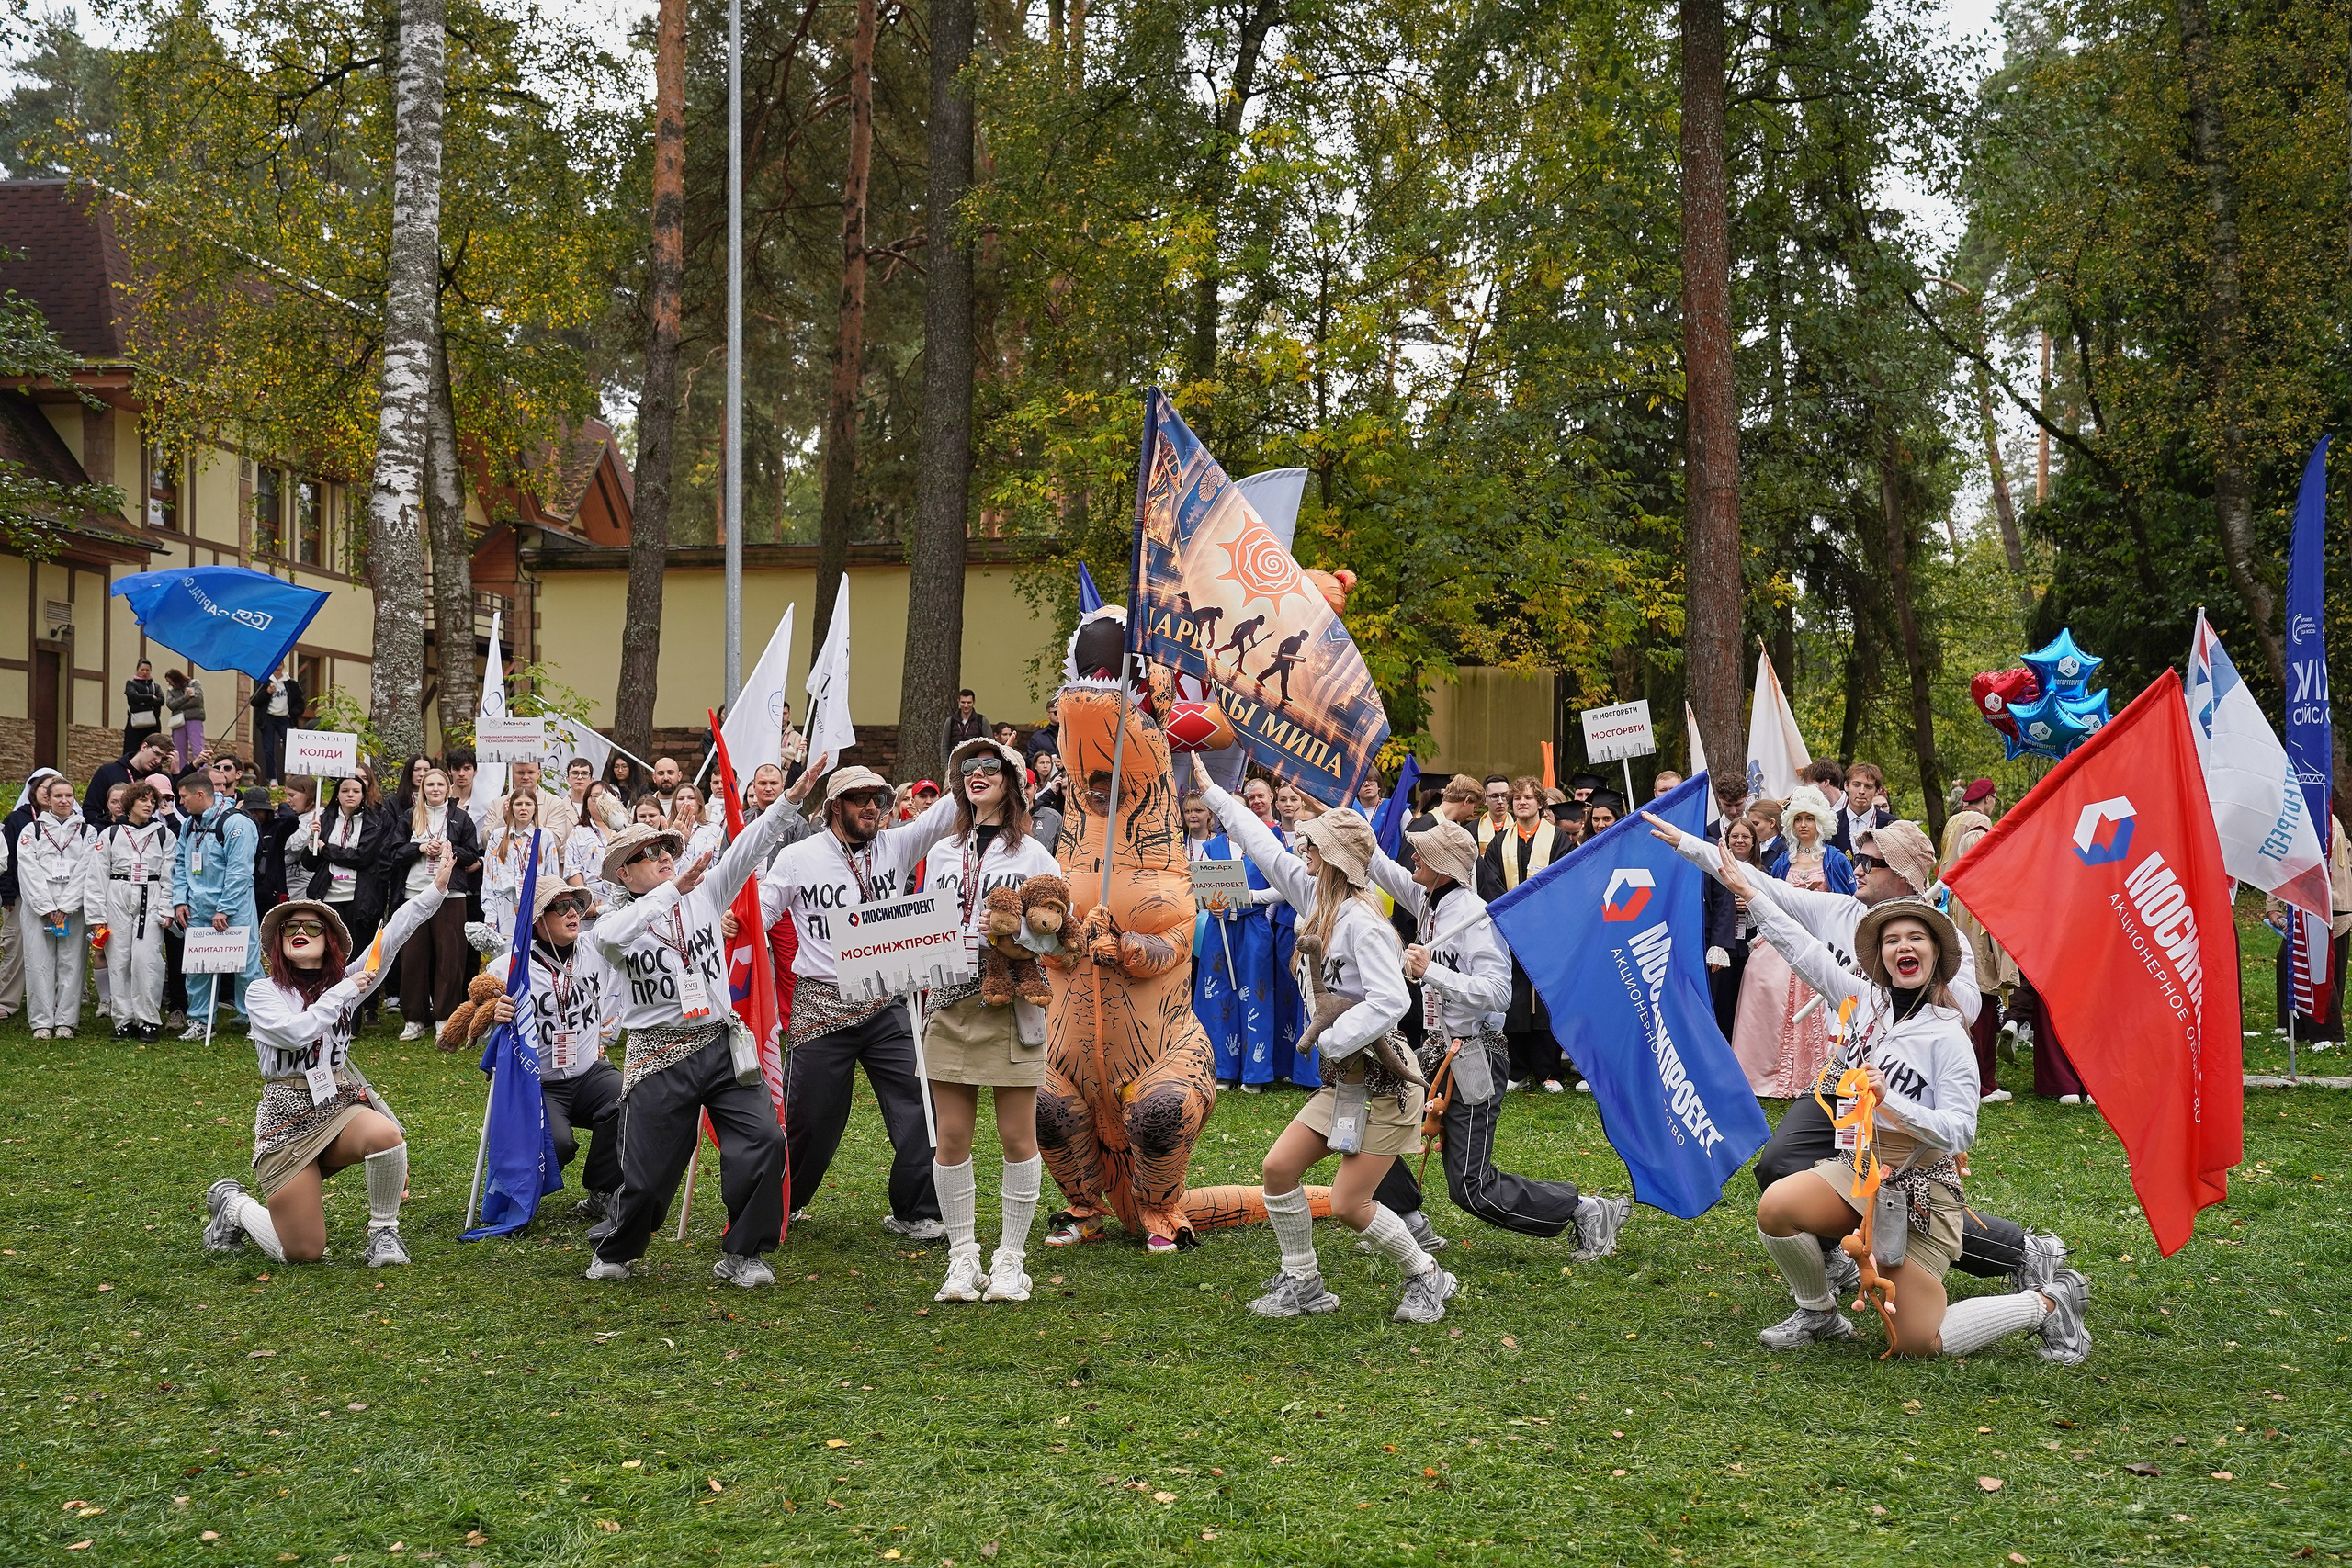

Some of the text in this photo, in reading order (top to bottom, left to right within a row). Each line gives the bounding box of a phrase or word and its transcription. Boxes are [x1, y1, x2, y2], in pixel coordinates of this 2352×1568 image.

[1600, 706, 1638, 720] МОСГОРБТИ
[1591, 724, 1645, 739] МОСГОРБТИ
[300, 748, 343, 760] КОЛДИ
[1258, 713, 1342, 780] МИПА
[1193, 881, 1245, 889] НАРХ-ПРОЕКТ
[861, 898, 936, 925] МОСИНЖПРОЕКТ
[841, 930, 958, 962] МОСИНЖПРОЕКТ
[2108, 893, 2189, 1022] АКЦИОНЕРНОЕ
[1611, 947, 1661, 1062] АКЦИОНЕРНО
